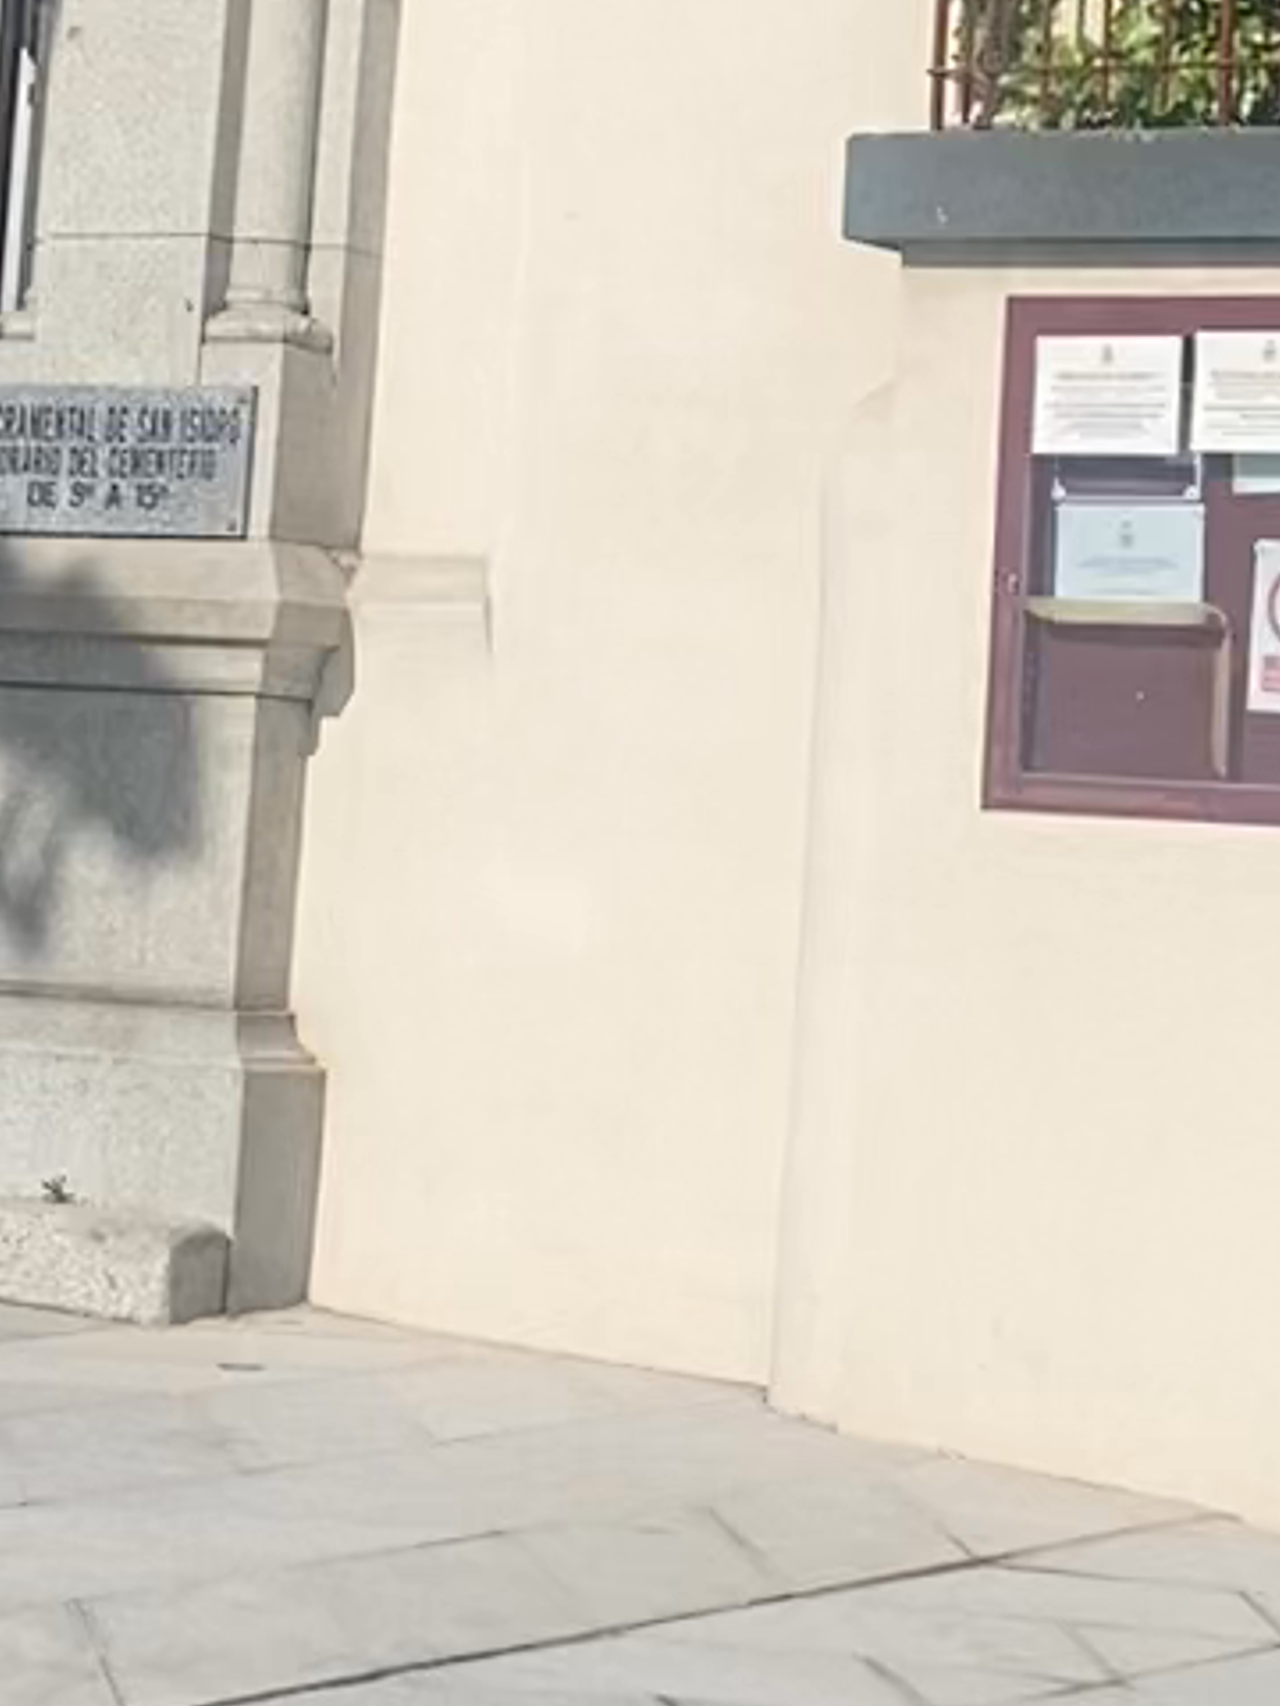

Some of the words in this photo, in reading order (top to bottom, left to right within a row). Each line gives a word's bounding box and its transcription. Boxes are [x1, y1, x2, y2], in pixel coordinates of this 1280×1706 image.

[105, 407, 130, 444] DE
[136, 407, 173, 444] SAN
[179, 408, 241, 446] ISIDRO
[68, 446, 99, 478] DEL
[107, 447, 218, 480] CEMENTERIO
[27, 481, 58, 510] DE
[104, 482, 123, 510] A
